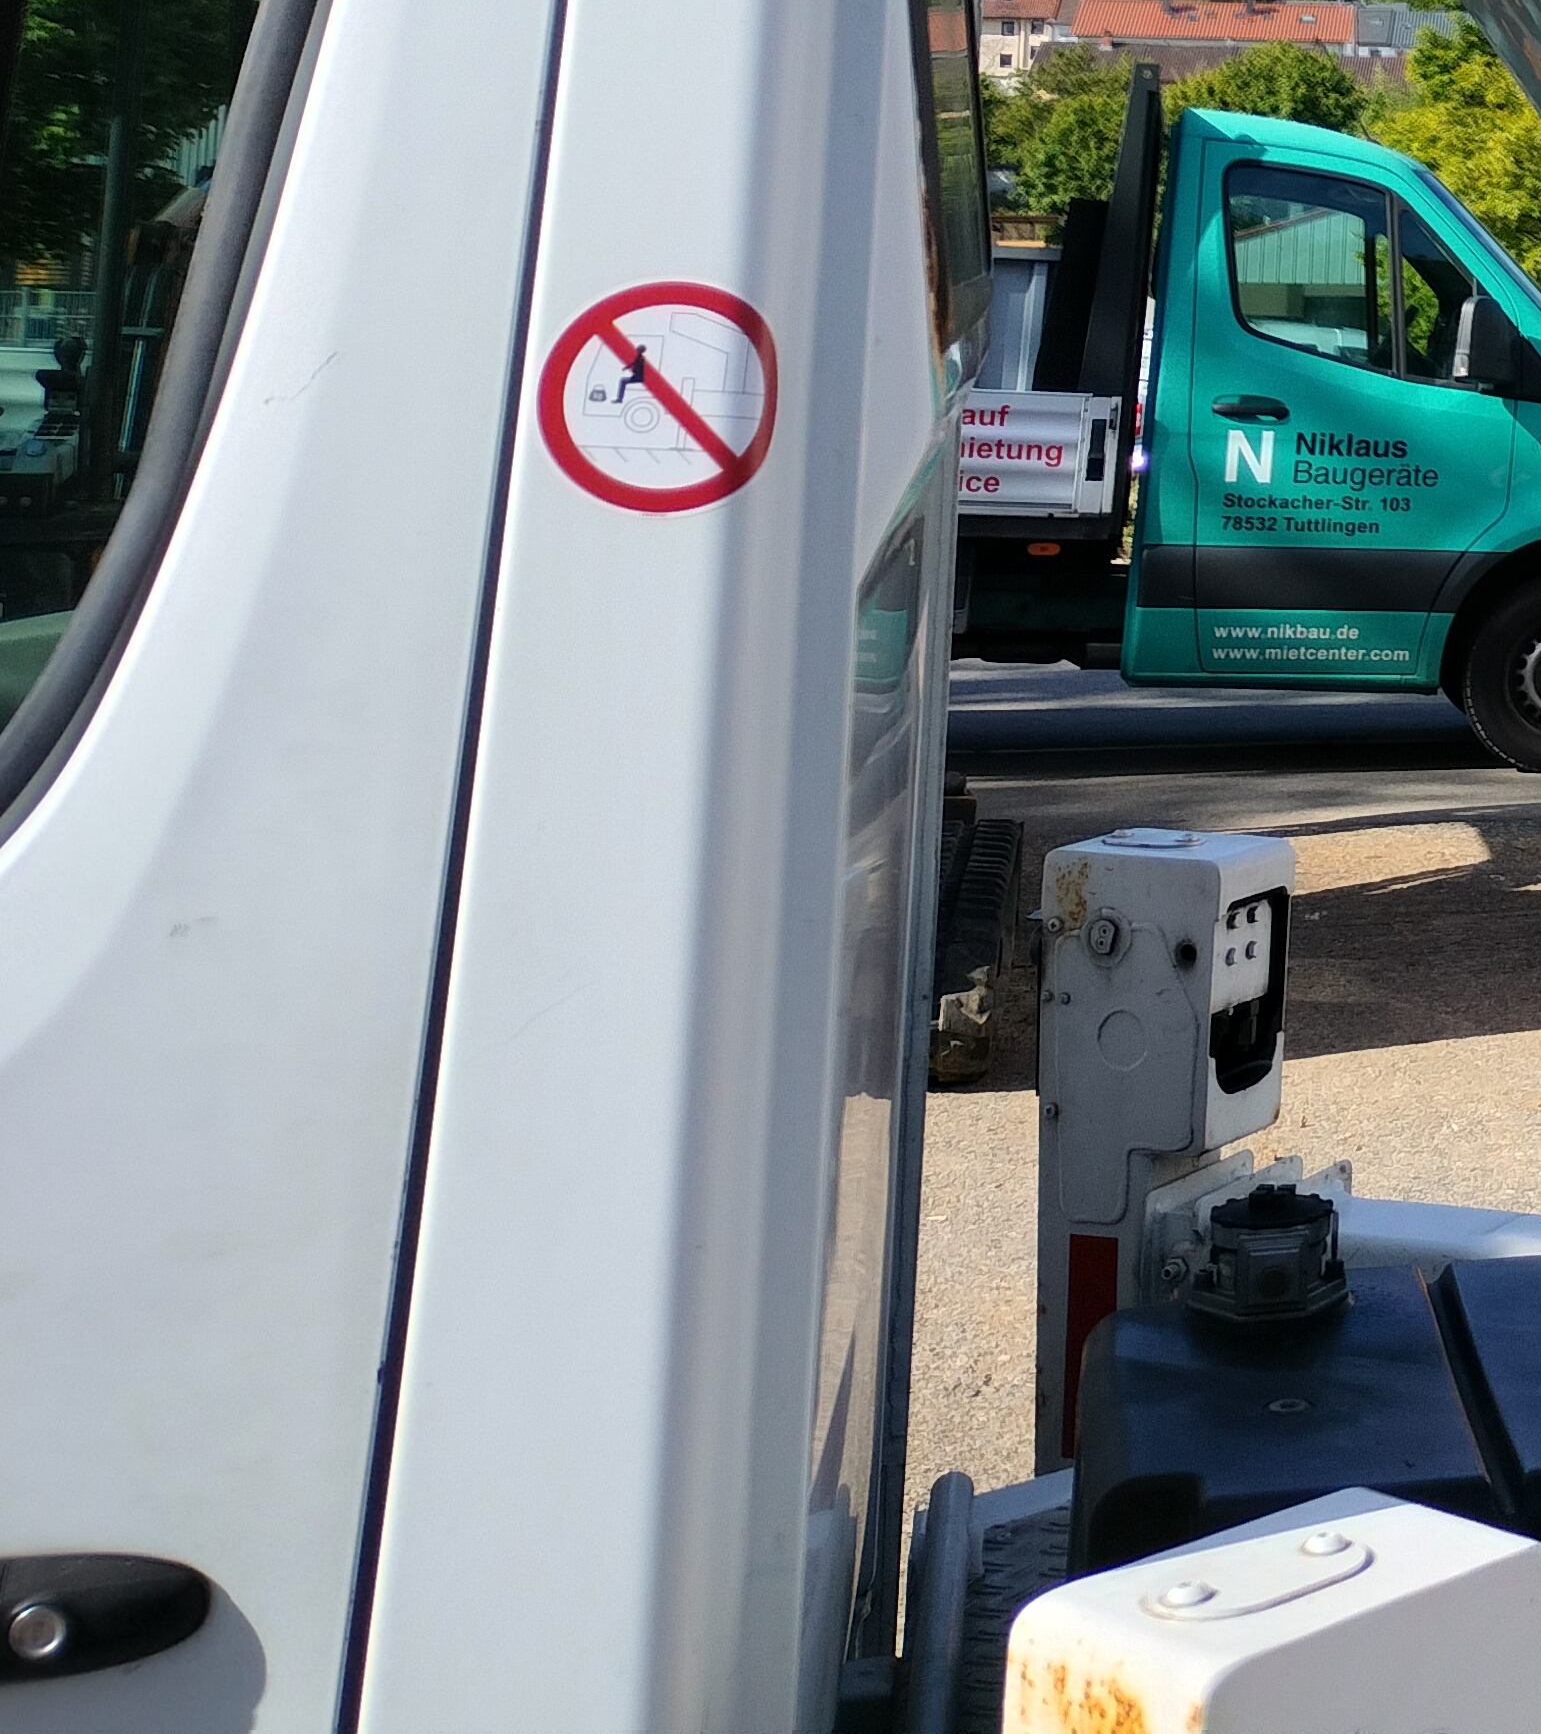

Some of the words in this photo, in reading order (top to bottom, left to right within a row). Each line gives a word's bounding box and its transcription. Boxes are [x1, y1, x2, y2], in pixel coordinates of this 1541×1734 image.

[961, 404, 1010, 427] auf
[1224, 428, 1276, 484] N
[1295, 431, 1408, 458] Niklaus
[958, 469, 1001, 493] ice
[1292, 459, 1440, 492] Baugeräte
[1222, 492, 1373, 512] Stockacher-Str.
[1380, 496, 1412, 512] 103
[1220, 515, 1278, 532] 78532
[1284, 516, 1380, 537] Tuttlingen
[1213, 623, 1359, 640] www.nikbau.de
[1211, 645, 1410, 662] www.mietcenter.com
